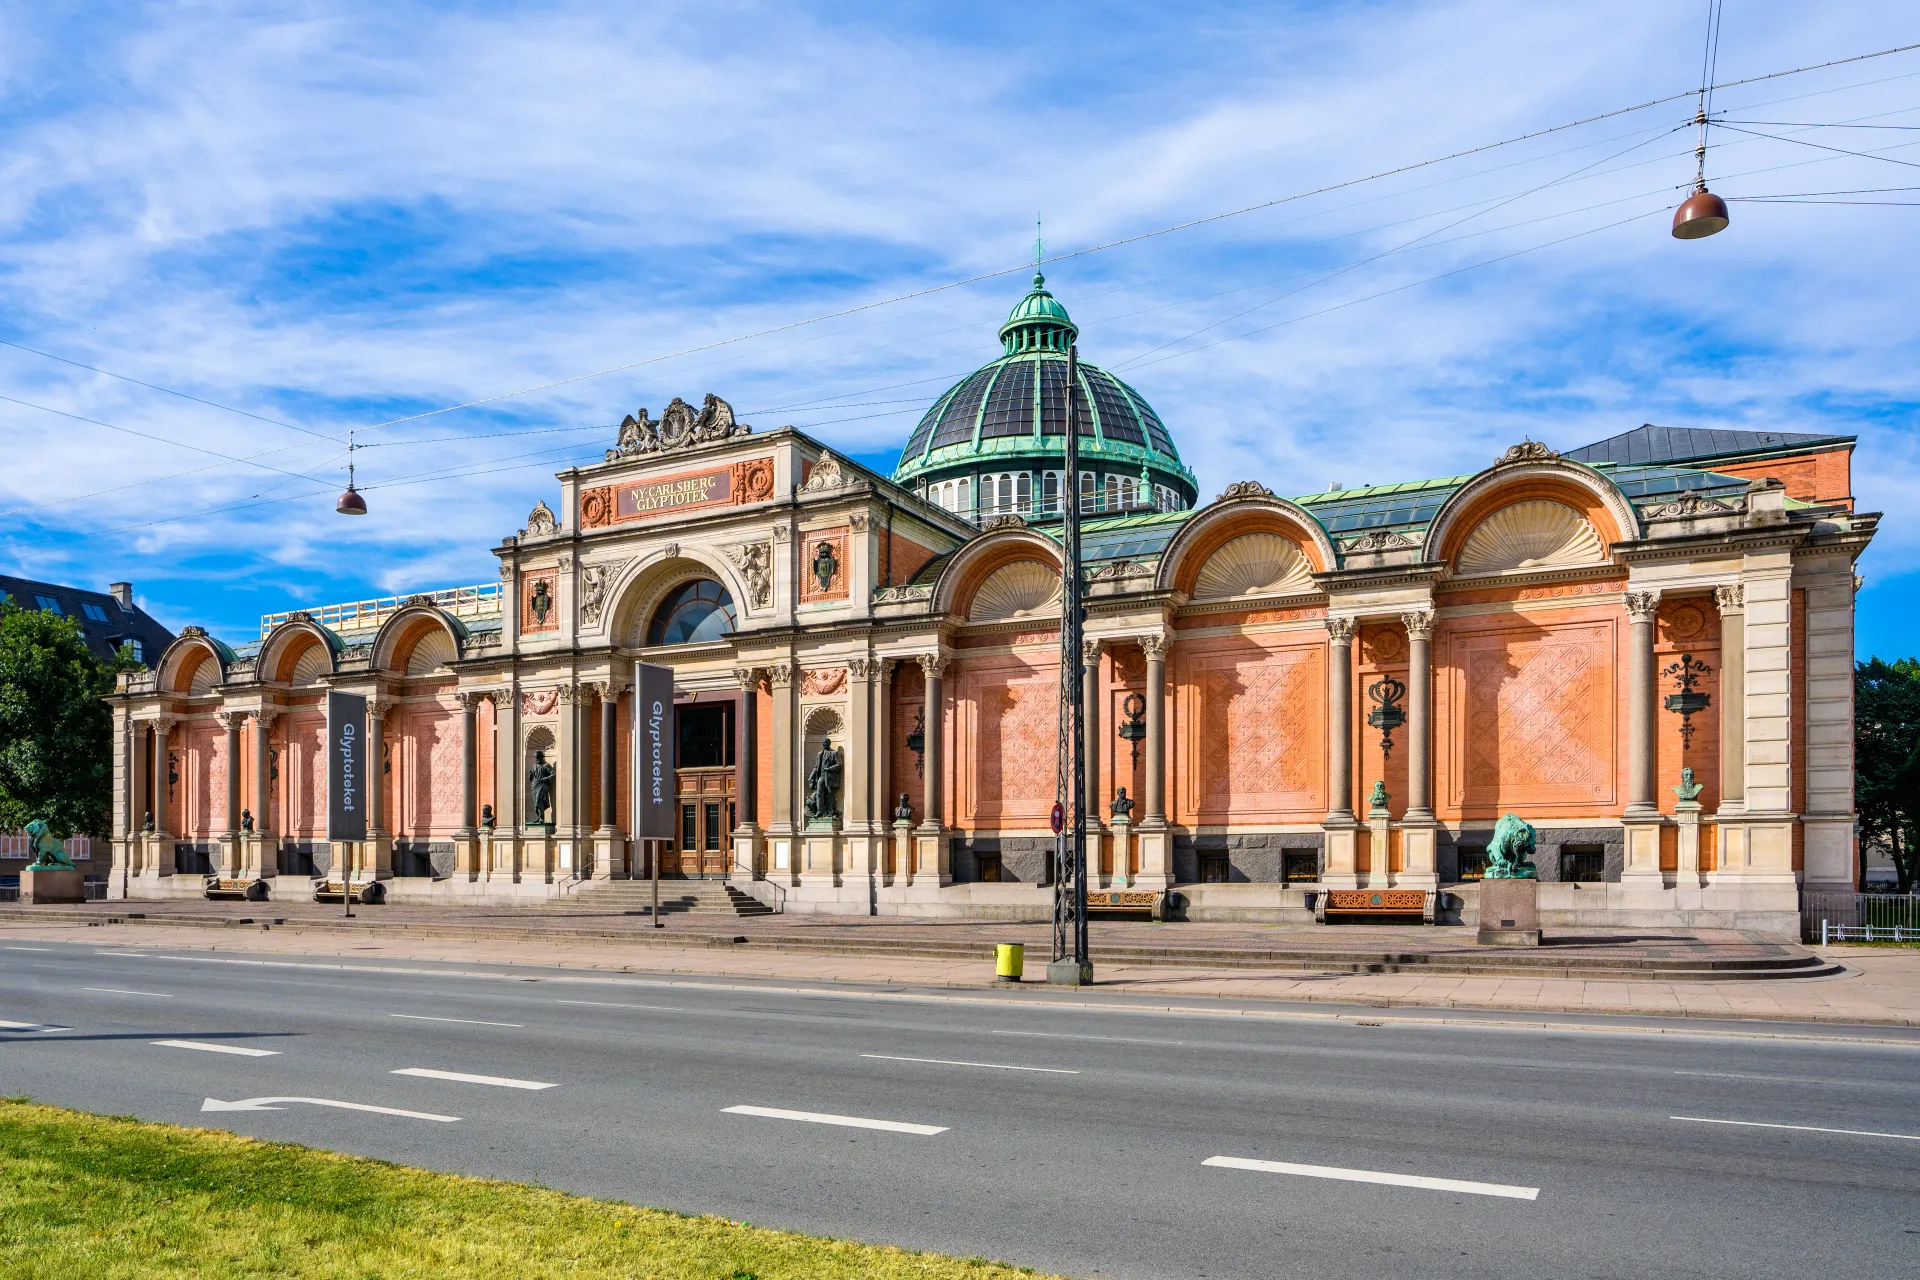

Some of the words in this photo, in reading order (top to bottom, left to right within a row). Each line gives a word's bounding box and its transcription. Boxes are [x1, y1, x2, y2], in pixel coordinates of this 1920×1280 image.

[637, 488, 710, 511] GLYPTOTEK
[689, 692, 697, 702] 7
[340, 723, 355, 812] Glyptoteket
[649, 700, 663, 804] Glyptoteket
